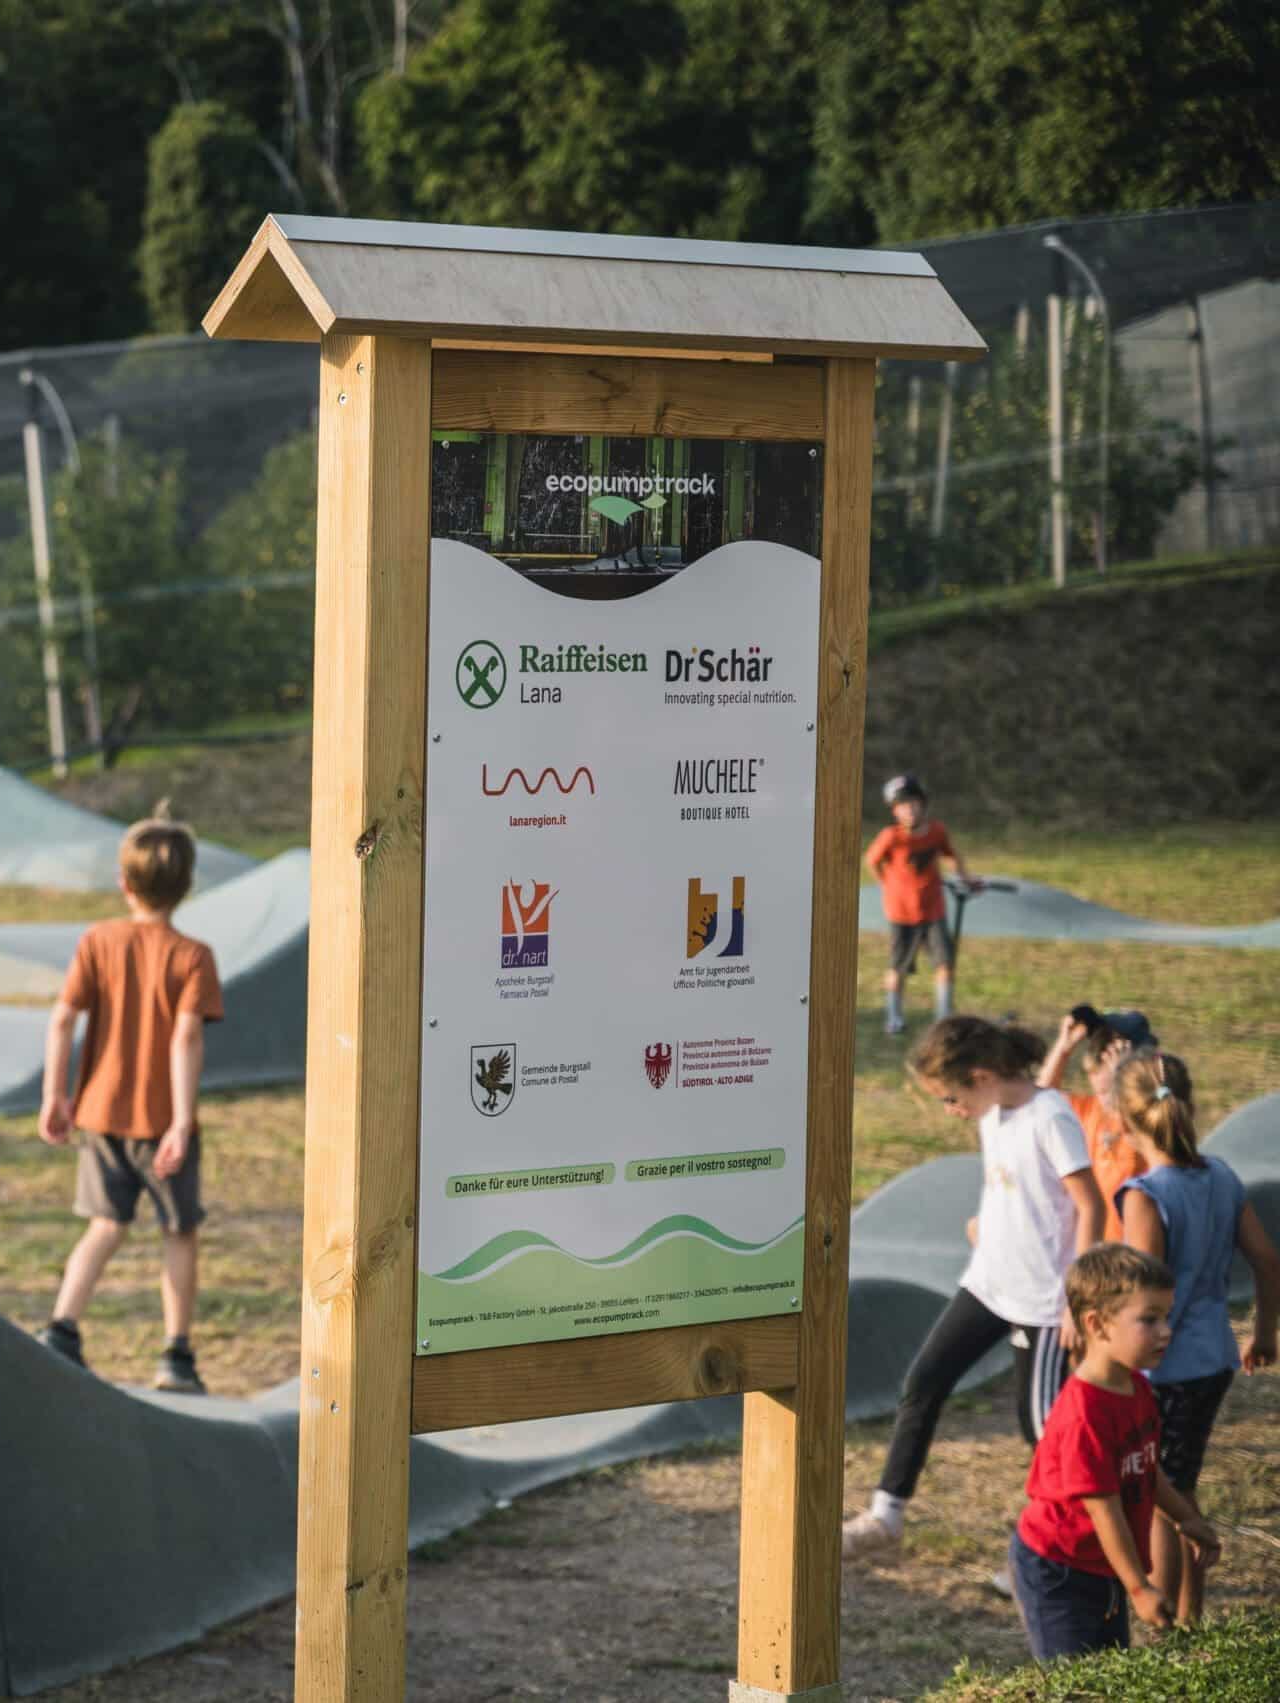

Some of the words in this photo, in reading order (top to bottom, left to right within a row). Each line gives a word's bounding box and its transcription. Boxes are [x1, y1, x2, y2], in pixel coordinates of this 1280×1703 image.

[545, 473, 715, 496] ecopumptrack
[519, 644, 648, 673] Raiffeisen
[520, 682, 562, 704] Lana
[664, 690, 715, 707] Innovating
[717, 689, 751, 707] special
[753, 689, 797, 704] nutrition.
[509, 813, 567, 828] lanaregion.it
[680, 807, 722, 821] BOUTIQUE
[725, 805, 751, 819] HOTEL
[679, 967, 694, 976] Amt
[695, 965, 706, 976] für
[495, 976, 526, 987] Apotheke
[673, 979, 696, 990] Ufficio
[521, 1064, 558, 1076] Gemeinde
[521, 1077, 549, 1087] Comune
[717, 1075, 734, 1086] ALTO
[734, 1073, 754, 1084] ADIGE
[637, 1165, 668, 1177] Grazie
[669, 1163, 686, 1177] per
[695, 1159, 726, 1172] vostro
[727, 1154, 772, 1170] sostegno!
[454, 1179, 487, 1193] Danke
[488, 1177, 504, 1190] für
[505, 1177, 529, 1189] eure
[531, 1169, 605, 1187] Unterstützung!
[574, 1308, 660, 1326] www.ecopumptrack.com
